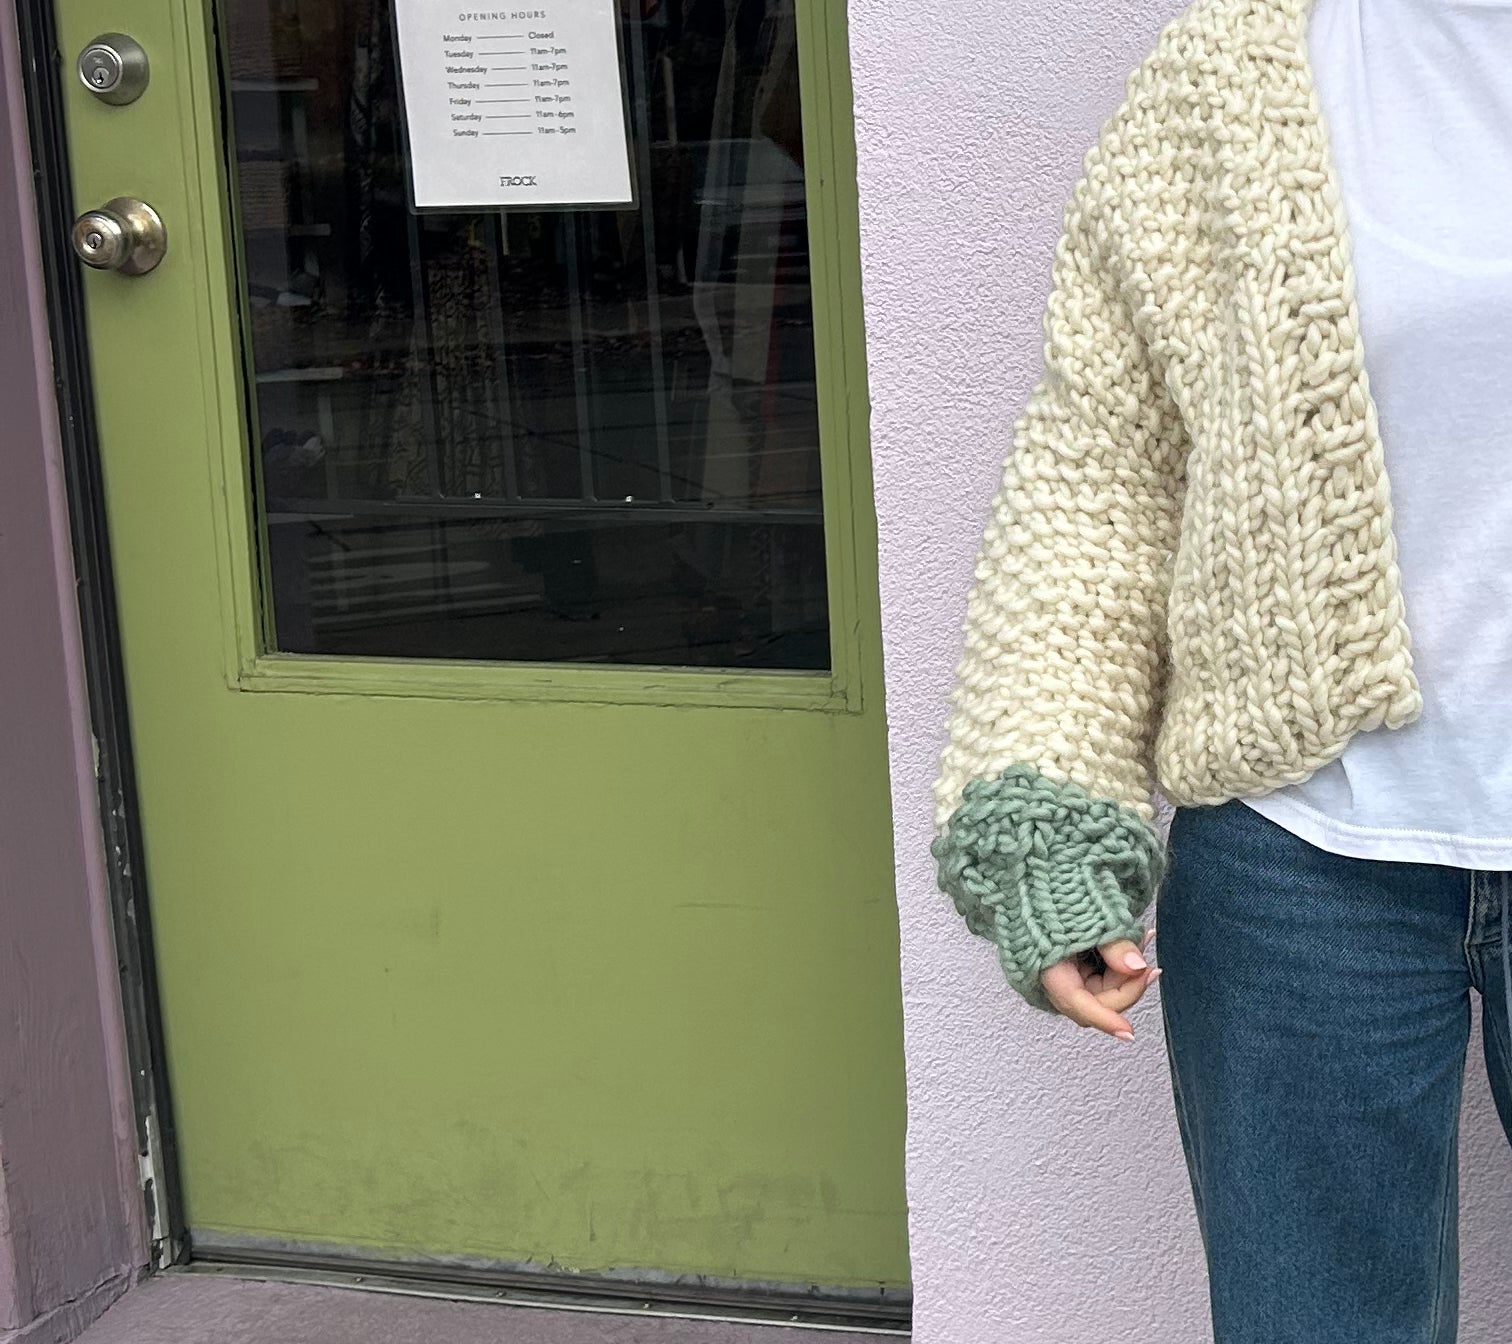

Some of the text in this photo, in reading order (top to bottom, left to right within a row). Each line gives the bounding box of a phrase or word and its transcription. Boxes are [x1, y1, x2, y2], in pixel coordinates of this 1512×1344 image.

[459, 10, 546, 21] OPENING HOURS
[443, 31, 555, 43] Monday Closed
[444, 50, 474, 59] Tuesday
[445, 66, 488, 75] Wednesday
[448, 81, 480, 90] Thursday
[449, 97, 471, 106] Friday
[451, 113, 482, 122] Saturday
[453, 129, 479, 138] Sunday
